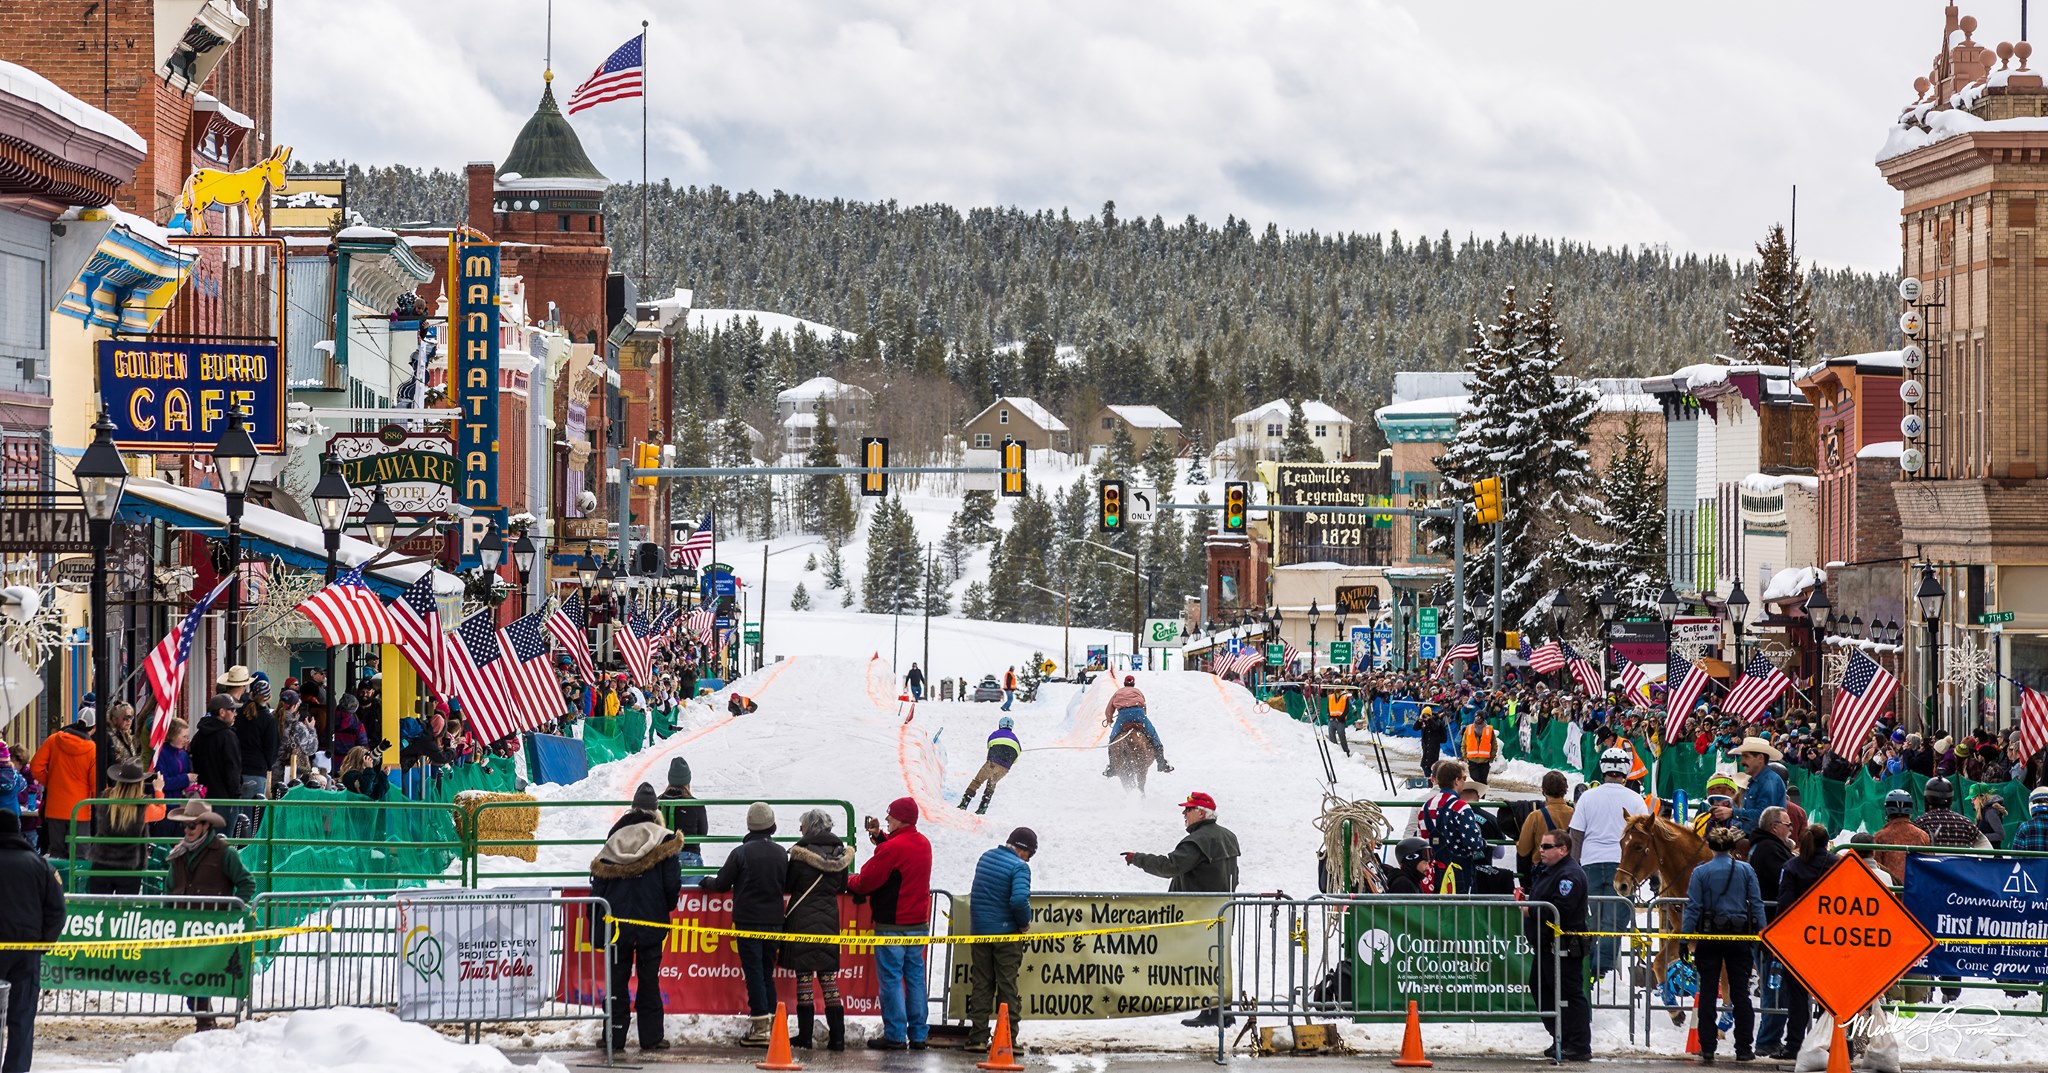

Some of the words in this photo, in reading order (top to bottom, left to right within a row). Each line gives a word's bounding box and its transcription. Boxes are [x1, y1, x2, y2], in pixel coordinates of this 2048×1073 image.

[114, 350, 187, 380] GOLDEN
[201, 353, 267, 382] BURRO
[129, 387, 256, 433] CAFE
[384, 431, 402, 440] 1886
[342, 454, 454, 484] ELAWARE
[1283, 469, 1350, 486] Leadville's
[1295, 488, 1364, 506] Legendary
[1131, 512, 1152, 520] ONLY
[1304, 511, 1366, 525] Saloon
[575, 529, 598, 537] HIVE
[1321, 528, 1361, 545] 1879
[1988, 614, 2000, 622] 7TH
[2004, 612, 2013, 621] ST
[1682, 625, 1708, 633] Coffee
[1230, 640, 1240, 653] H
[1818, 895, 1879, 916] ROAD
[1946, 892, 2026, 914] Community
[1091, 903, 1184, 925] Mercantile
[1936, 914, 1973, 935] First
[458, 940, 498, 949] BEHIND
[501, 939, 537, 948] EVERY
[1093, 934, 1158, 955] AMMO
[1803, 926, 1892, 948] CLOSED
[459, 950, 502, 959] PROJECT
[1396, 933, 1511, 960] Community
[1987, 945, 1997, 955] in
[2000, 945, 2041, 958] Historic
[1396, 955, 1413, 973] of
[1956, 958, 1989, 971] Come
[1993, 963, 2031, 976] grow
[1041, 963, 1125, 985] CAMPING
[1397, 981, 1443, 994] Where
[1446, 984, 1504, 994] common
[846, 995, 872, 1012] Dogs
[1030, 994, 1094, 1016] LIQUOR
